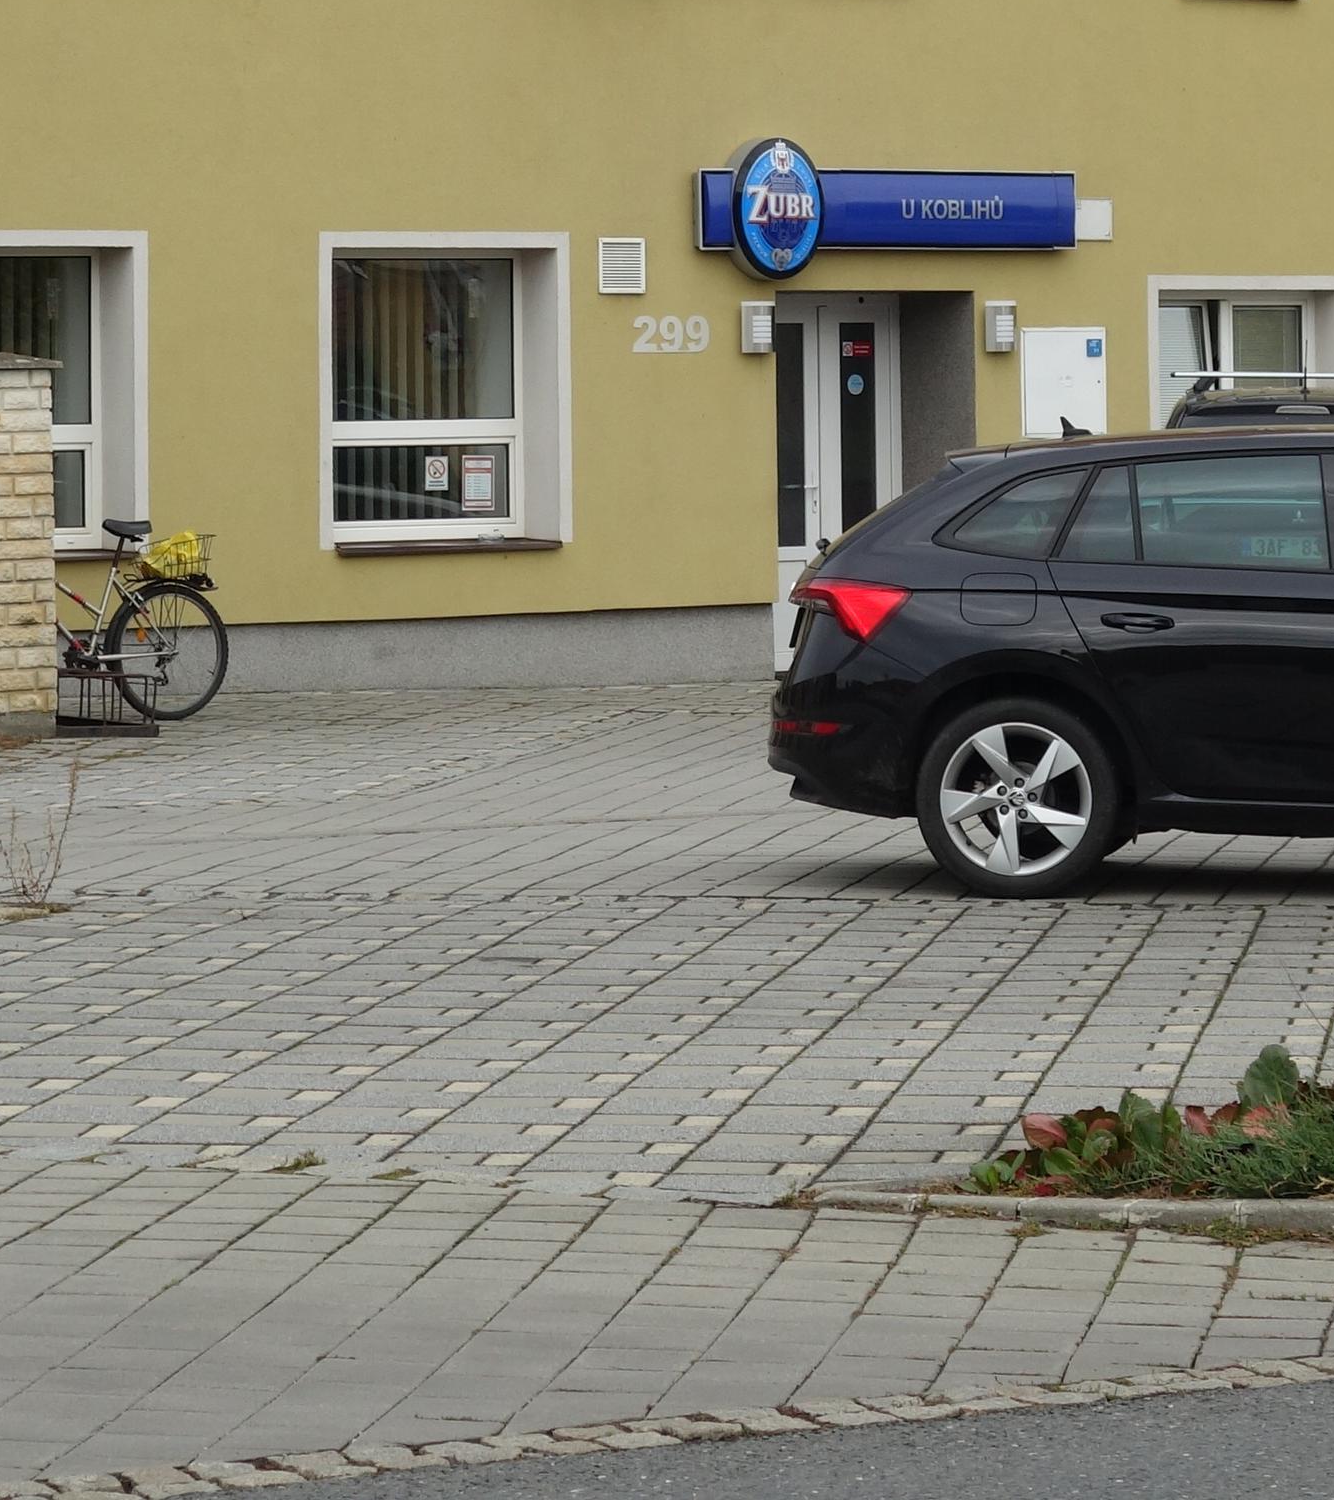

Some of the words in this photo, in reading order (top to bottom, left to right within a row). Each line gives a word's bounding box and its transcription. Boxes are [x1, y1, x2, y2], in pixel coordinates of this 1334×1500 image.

[747, 184, 818, 224] ZUBR
[901, 199, 915, 220] U
[921, 195, 1004, 220] KOBLIHŮ
[632, 315, 710, 353] 299
[1255, 539, 1288, 557] 3AF
